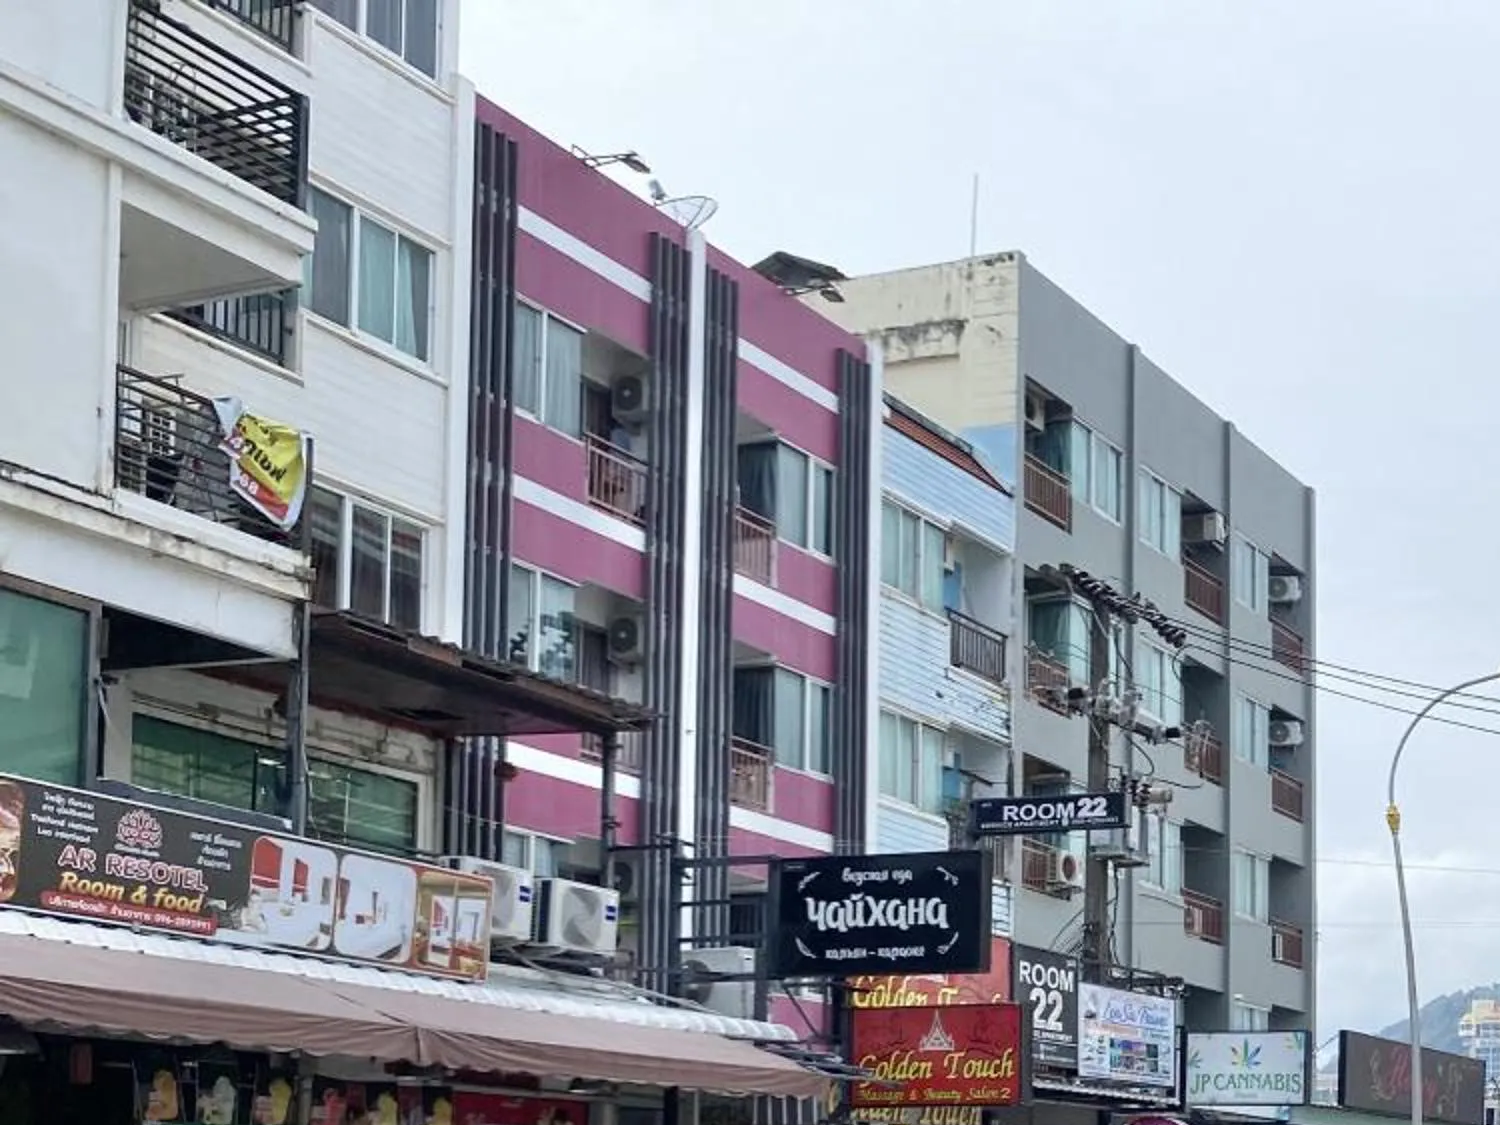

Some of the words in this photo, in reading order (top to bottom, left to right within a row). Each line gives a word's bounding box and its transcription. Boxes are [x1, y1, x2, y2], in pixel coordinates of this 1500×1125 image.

[58, 844, 97, 873] AR
[105, 853, 209, 893] RESOTEL
[59, 871, 125, 901] Room
[131, 886, 148, 905] &
[153, 888, 204, 914] food
[1019, 960, 1074, 993] ROOM
[1029, 987, 1064, 1032] 22
[943, 1048, 1016, 1080] Touch
[1190, 1073, 1211, 1095] JP
[1213, 1073, 1301, 1094] CANNABIS
